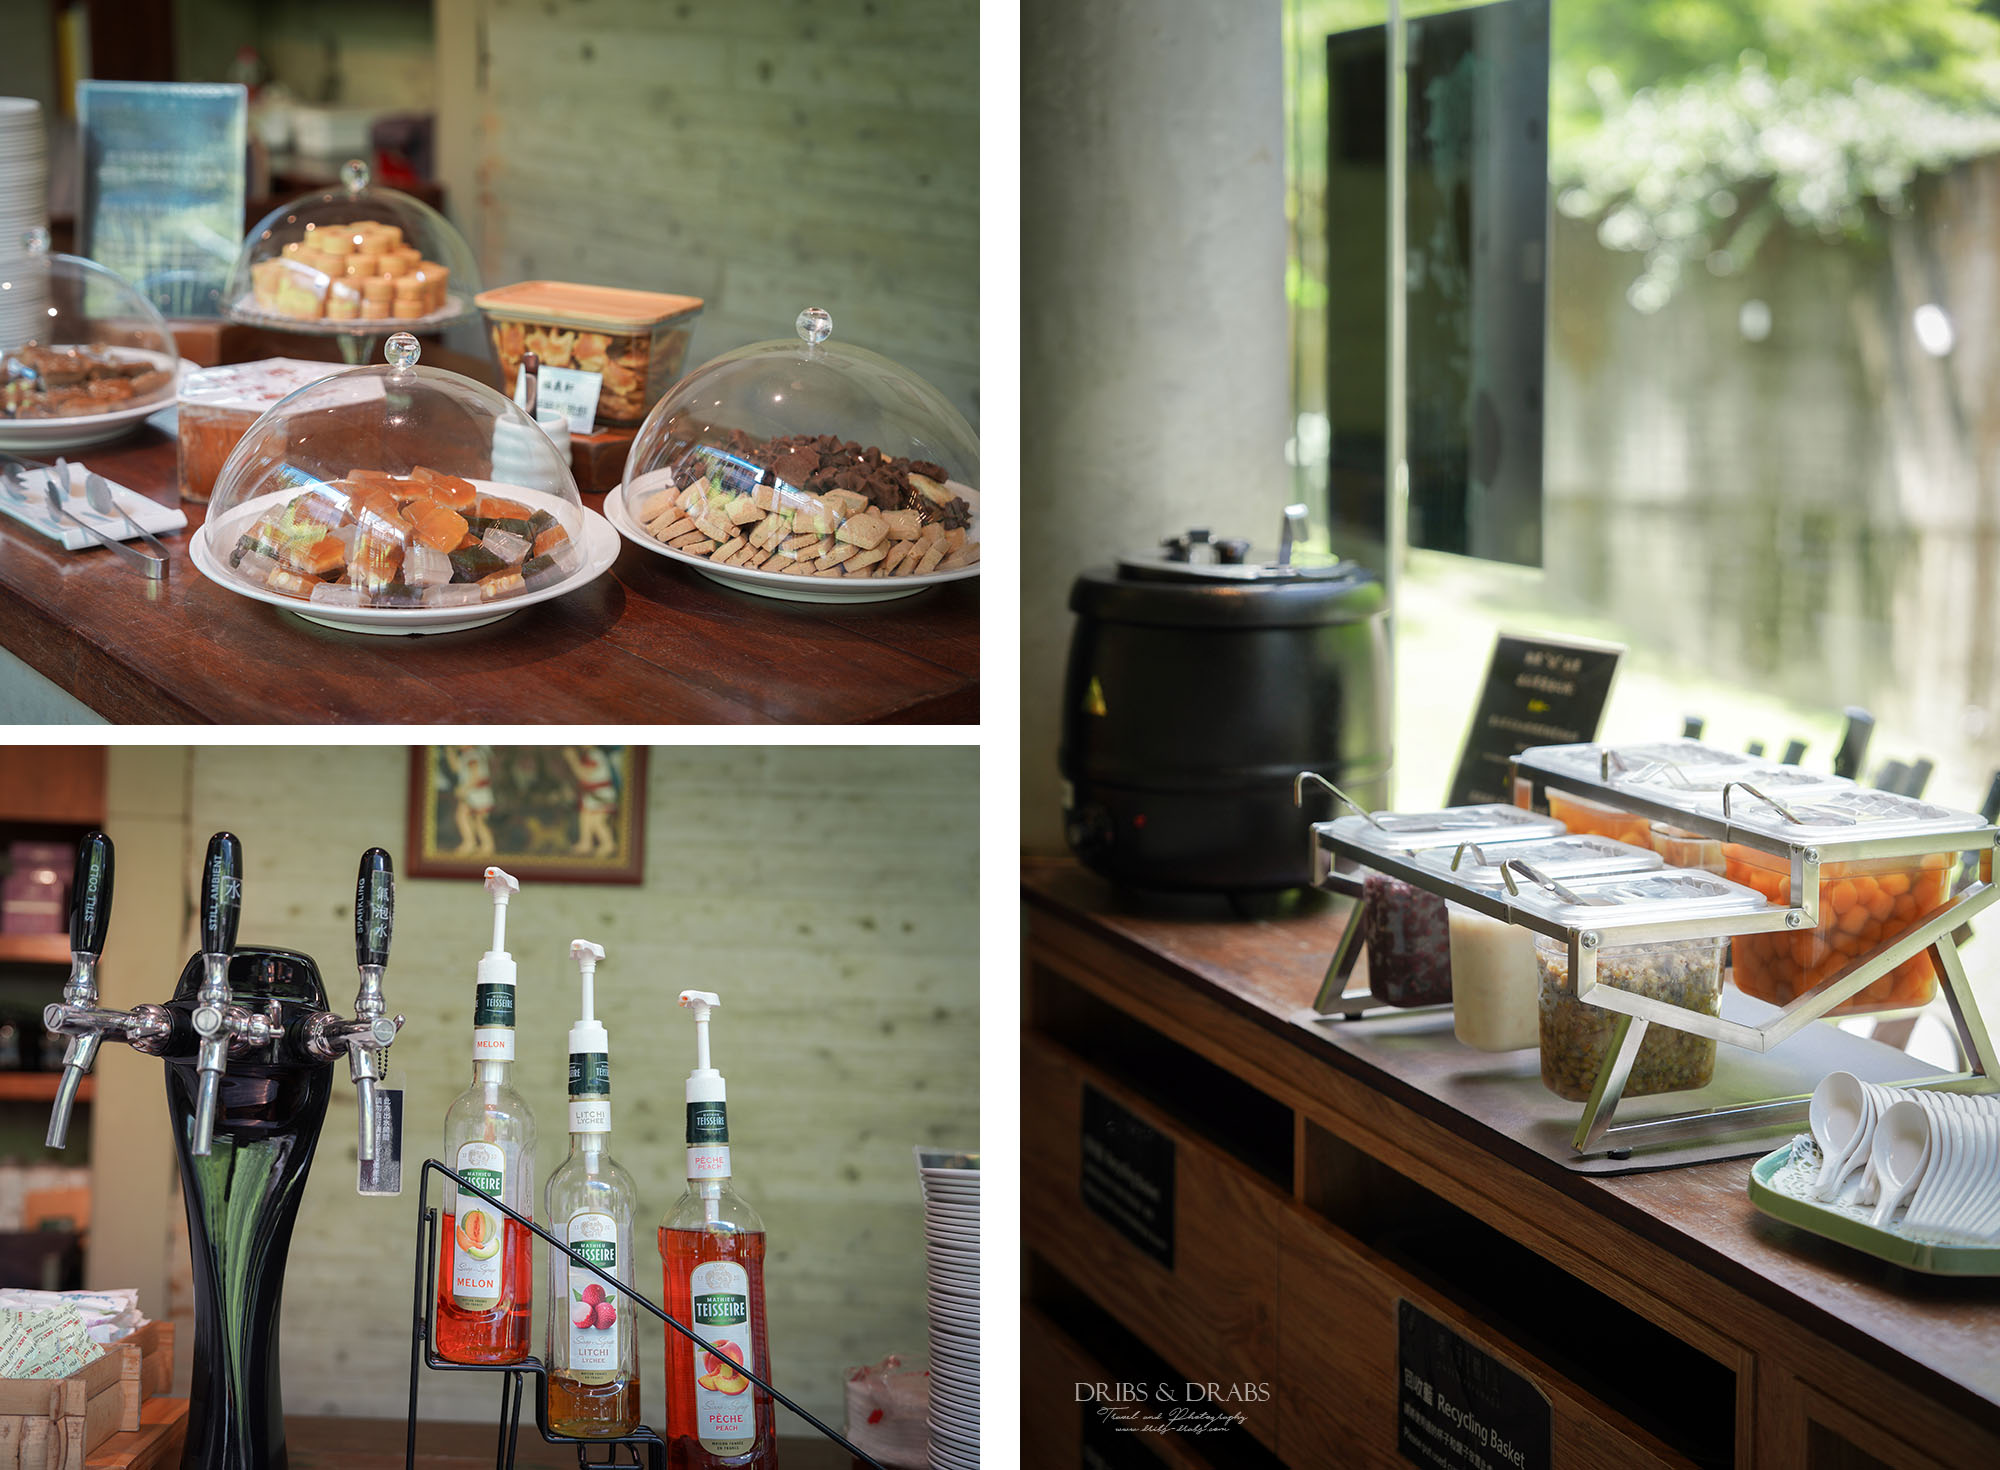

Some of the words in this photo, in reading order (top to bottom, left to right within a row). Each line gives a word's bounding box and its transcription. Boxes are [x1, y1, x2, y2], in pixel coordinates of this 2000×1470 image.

[88, 864, 99, 892] COLD
[210, 855, 222, 899] AMBIENT
[225, 880, 240, 899] 水
[85, 896, 96, 922] STILL
[357, 878, 366, 934] SPARKLING
[375, 886, 390, 938] 氣泡水
[208, 903, 218, 931] STILL
[486, 998, 513, 1008] TEISSEIRE
[476, 1040, 505, 1049] MELON
[575, 1111, 605, 1119] LITCHI
[697, 1116, 725, 1126] TEISSEIRE
[695, 1154, 724, 1165] PÊCHE
[460, 1176, 501, 1190] ISSEIRE
[457, 1277, 494, 1288] MELON
[696, 1302, 745, 1317] TEISSEIRE
[578, 1348, 609, 1356] LITCHI
[709, 1412, 744, 1424] PÊCHE
[1437, 1393, 1489, 1447] Recycling
[1490, 1428, 1526, 1470] Basket
